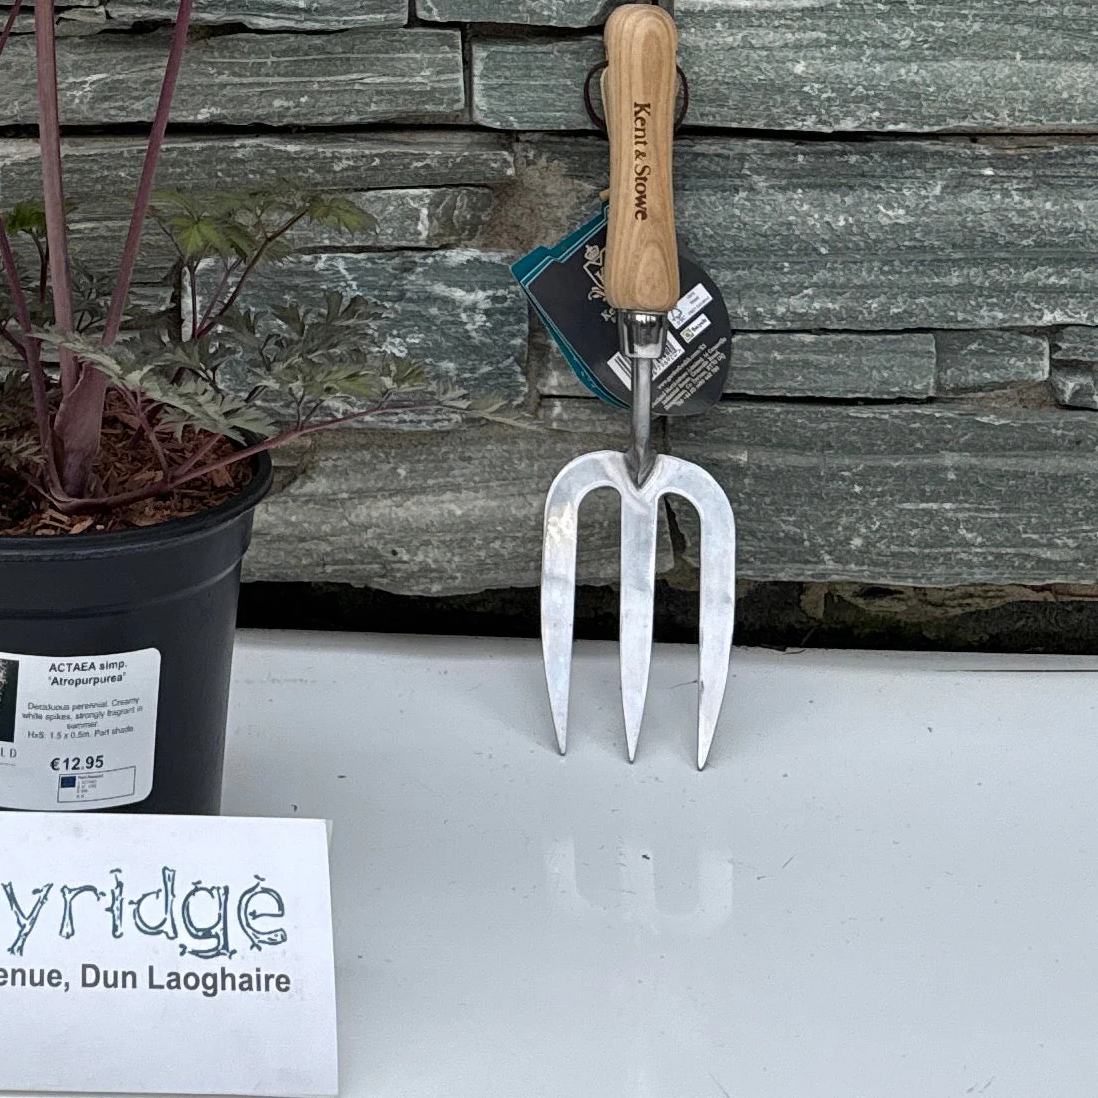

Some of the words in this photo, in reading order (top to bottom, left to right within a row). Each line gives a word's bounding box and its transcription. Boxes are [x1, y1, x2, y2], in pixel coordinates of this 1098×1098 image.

[634, 102, 651, 146] Kent
[635, 149, 647, 161] &
[634, 164, 651, 221] Stowe
[49, 662, 96, 673] ACTAEA
[50, 755, 104, 771] €12.95
[81, 965, 138, 990] Dun
[148, 967, 292, 998] Laoghaire
